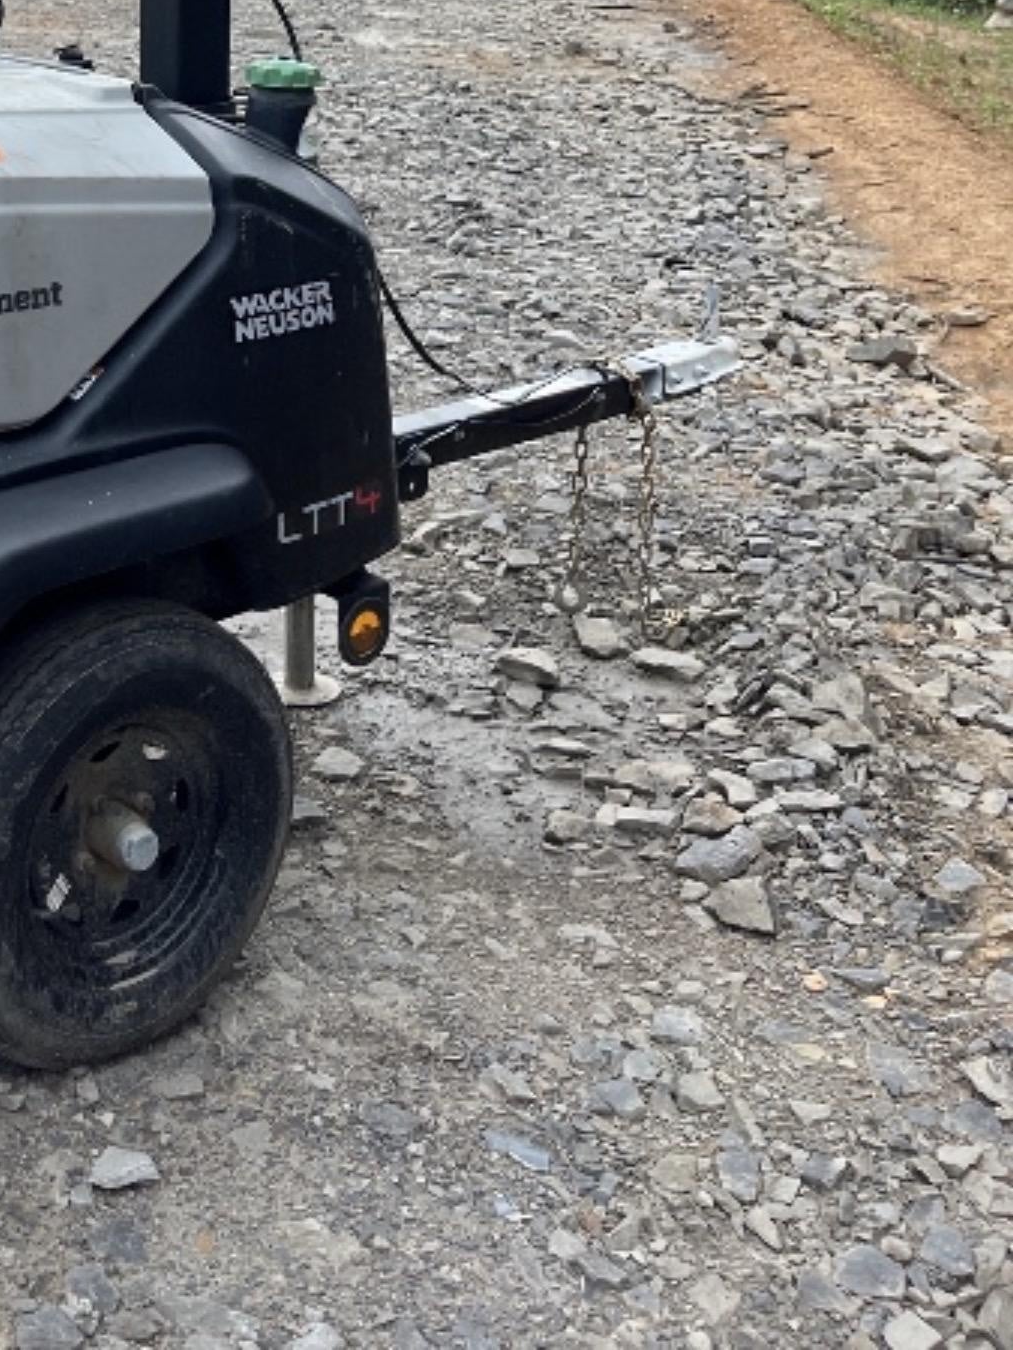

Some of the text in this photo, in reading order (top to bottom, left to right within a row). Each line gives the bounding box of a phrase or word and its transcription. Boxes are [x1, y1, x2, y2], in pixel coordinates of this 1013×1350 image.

[229, 280, 333, 319] WACKER
[235, 303, 335, 343] NEUSON
[277, 486, 381, 544] LTT4
